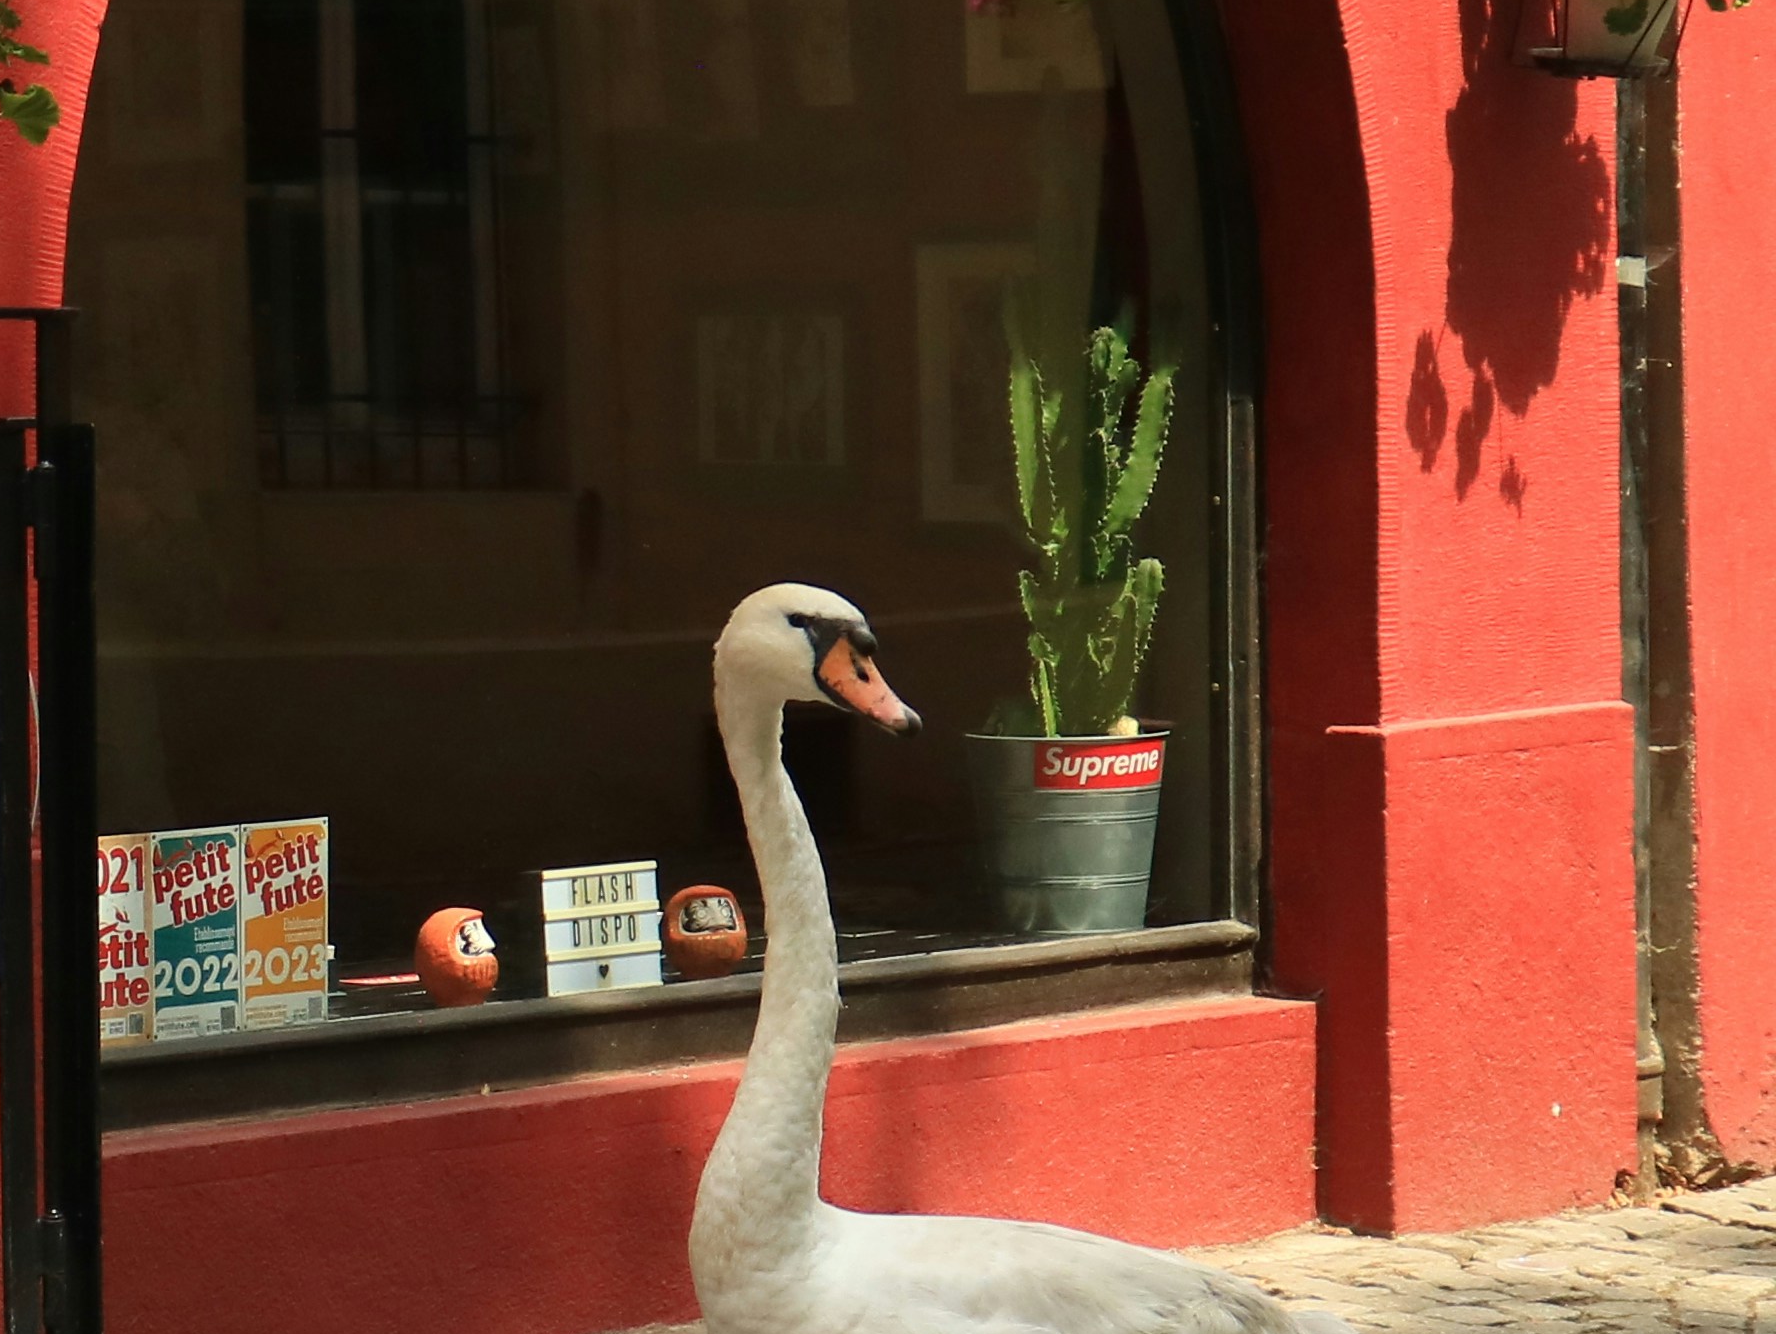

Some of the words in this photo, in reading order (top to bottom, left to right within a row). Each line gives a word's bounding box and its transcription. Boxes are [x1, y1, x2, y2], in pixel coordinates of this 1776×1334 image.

[1042, 747, 1159, 785] Supreme
[153, 842, 231, 904] petit
[245, 833, 320, 895] petit
[171, 875, 235, 927] futé
[261, 867, 324, 917] futé
[571, 872, 634, 906] FLASH
[572, 914, 637, 948] DISPO
[154, 953, 239, 997] 2022
[243, 943, 327, 987] 2023
